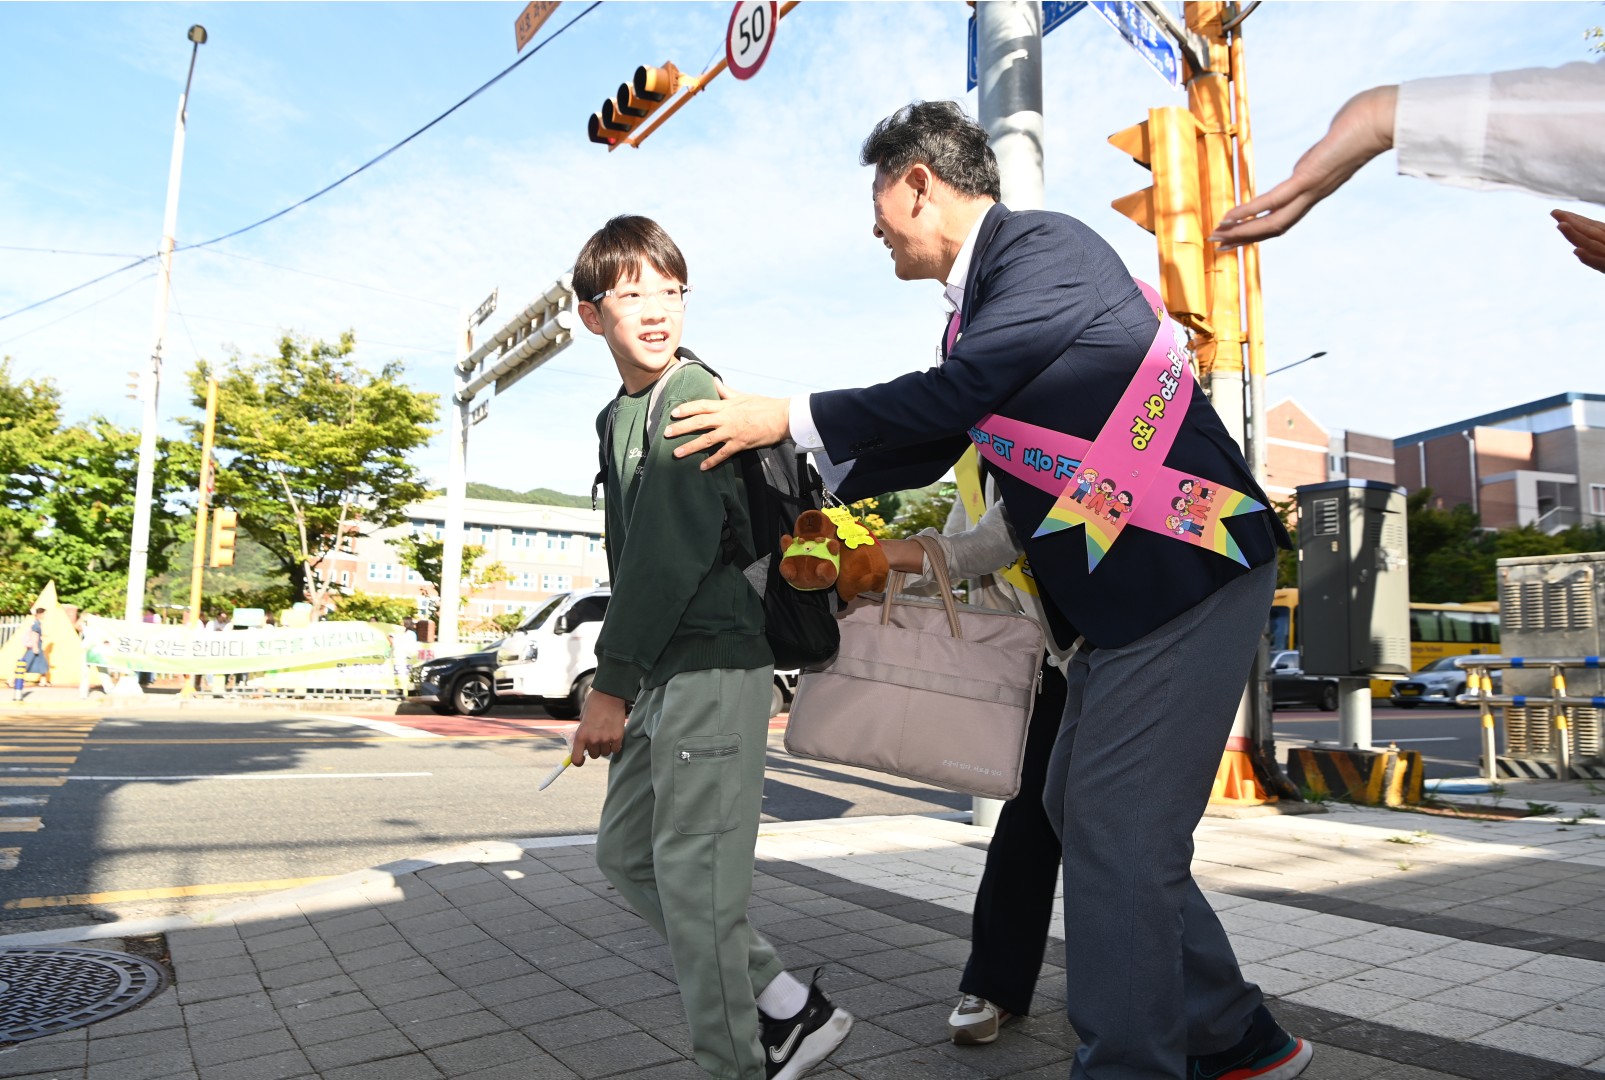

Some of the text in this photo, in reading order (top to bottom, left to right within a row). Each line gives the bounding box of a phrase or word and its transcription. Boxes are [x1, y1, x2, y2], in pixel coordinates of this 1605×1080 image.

[739, 5, 765, 55] 50
[118, 636, 148, 655] 용기
[154, 639, 185, 657] 있는
[256, 637, 304, 656] 친구를
